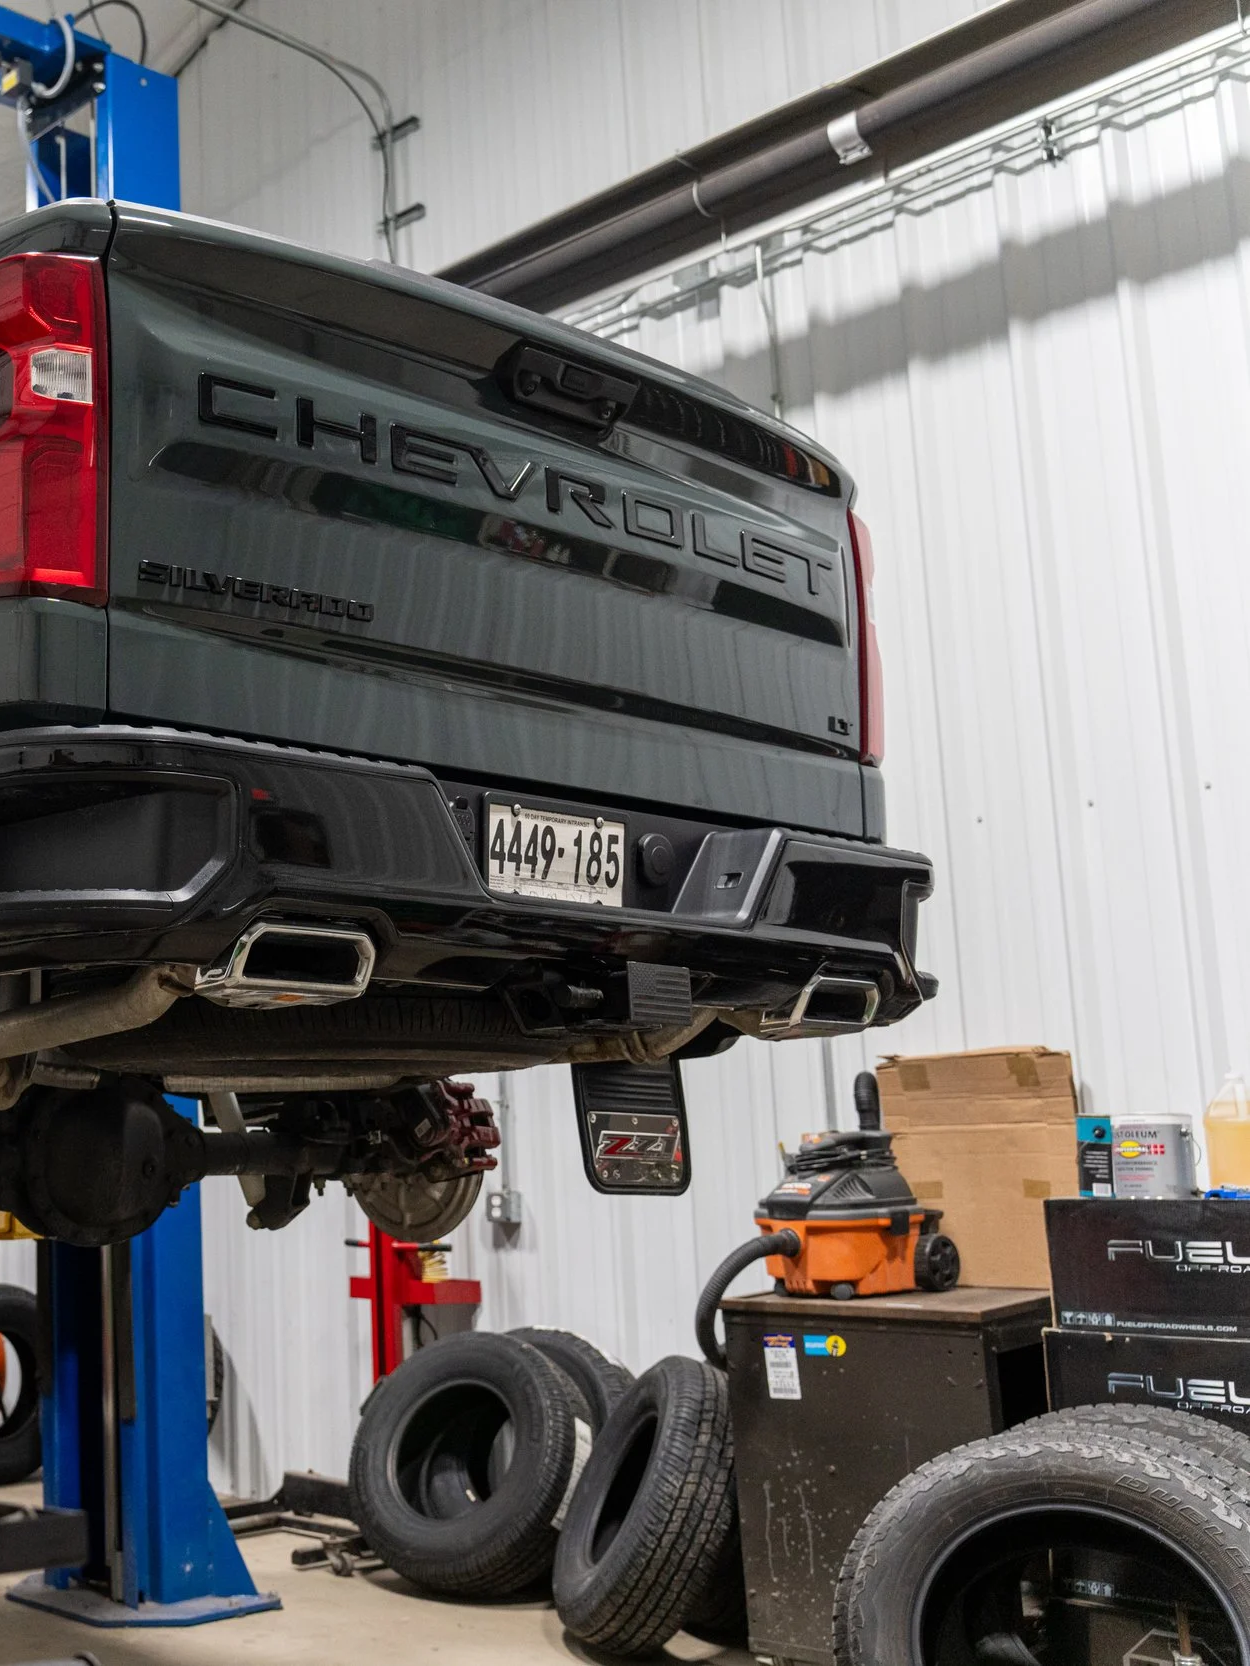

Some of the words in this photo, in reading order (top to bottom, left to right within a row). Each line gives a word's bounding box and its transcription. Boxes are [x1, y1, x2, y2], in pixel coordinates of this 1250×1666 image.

[198, 371, 833, 596] CHEVROLET
[138, 559, 375, 622] SILVERADO
[827, 716, 853, 736] LT
[531, 813, 540, 821] DAY
[540, 815, 567, 825] TEMPORARY
[489, 818, 620, 889] 4449-185
[598, 1135, 676, 1158] Z71
[1107, 1239, 1250, 1264] FUEL
[1116, 1320, 1238, 1333] FUELOFFROADWHEELS.COM
[1107, 1372, 1250, 1405] FUEL
[1114, 1473, 1250, 1582] DUELE
